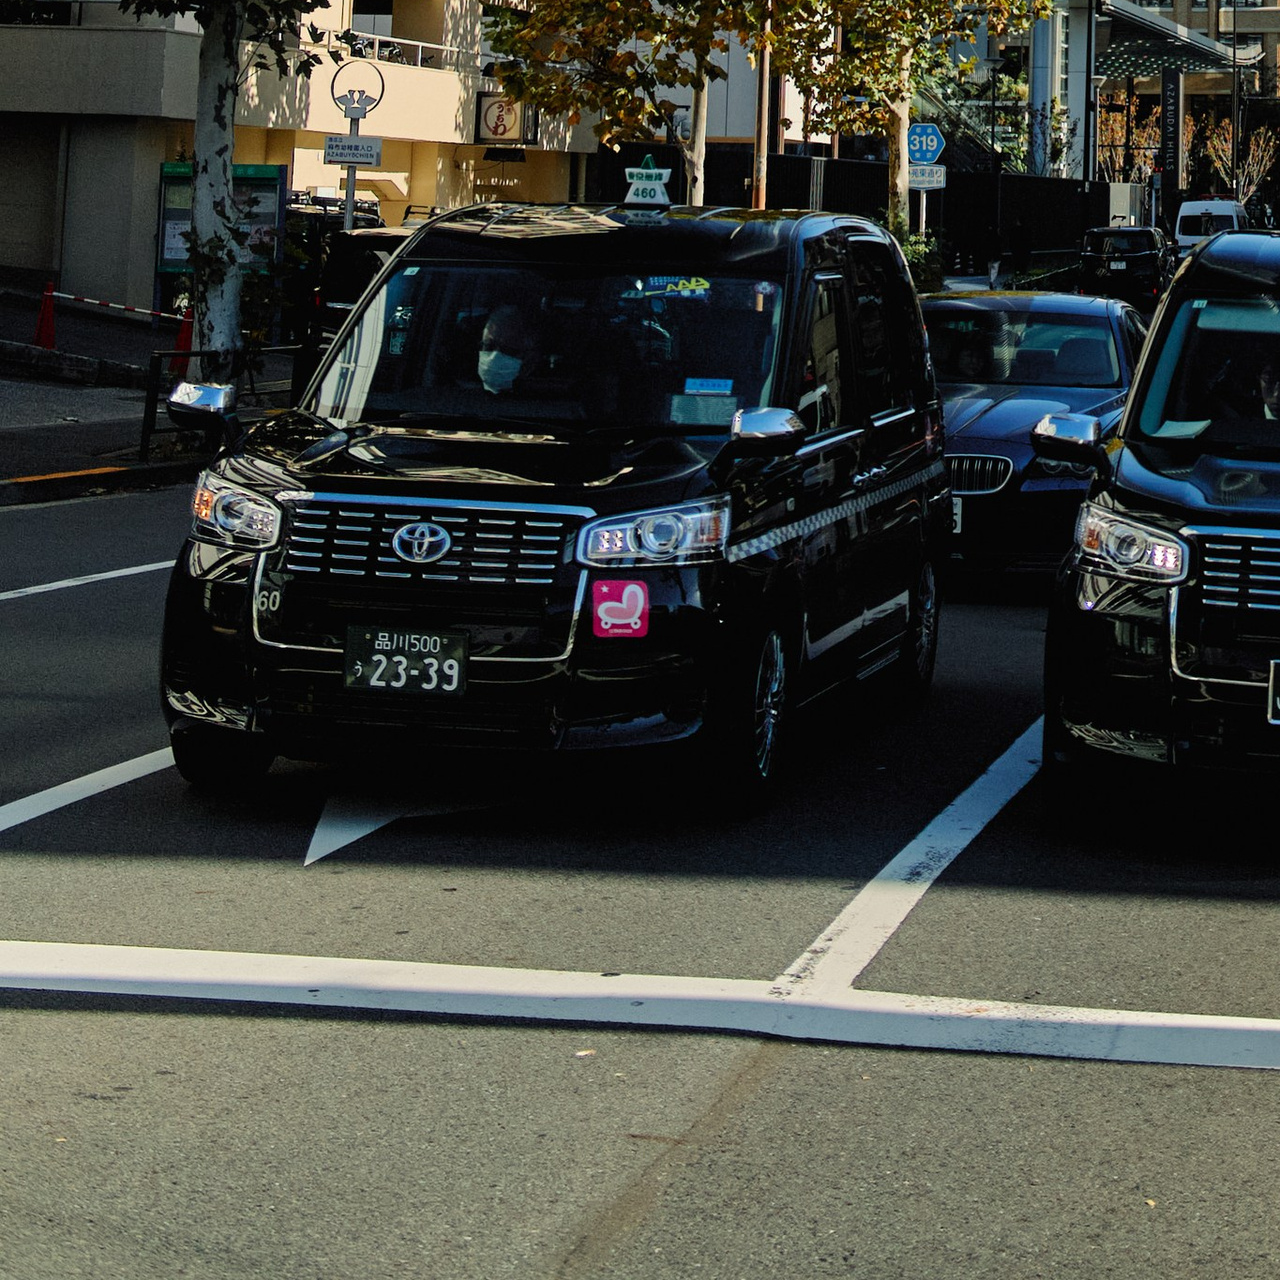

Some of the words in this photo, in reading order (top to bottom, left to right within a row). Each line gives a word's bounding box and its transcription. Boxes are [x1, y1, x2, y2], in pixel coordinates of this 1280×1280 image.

[492, 103, 508, 136] うちわ
[1166, 83, 1175, 137] AZABUDAI
[909, 135, 938, 151] 319
[1166, 141, 1175, 171] HILLS
[633, 187, 657, 199] 460
[374, 632, 441, 653] 品川500
[354, 660, 363, 677] う
[369, 654, 459, 691] 23-39
